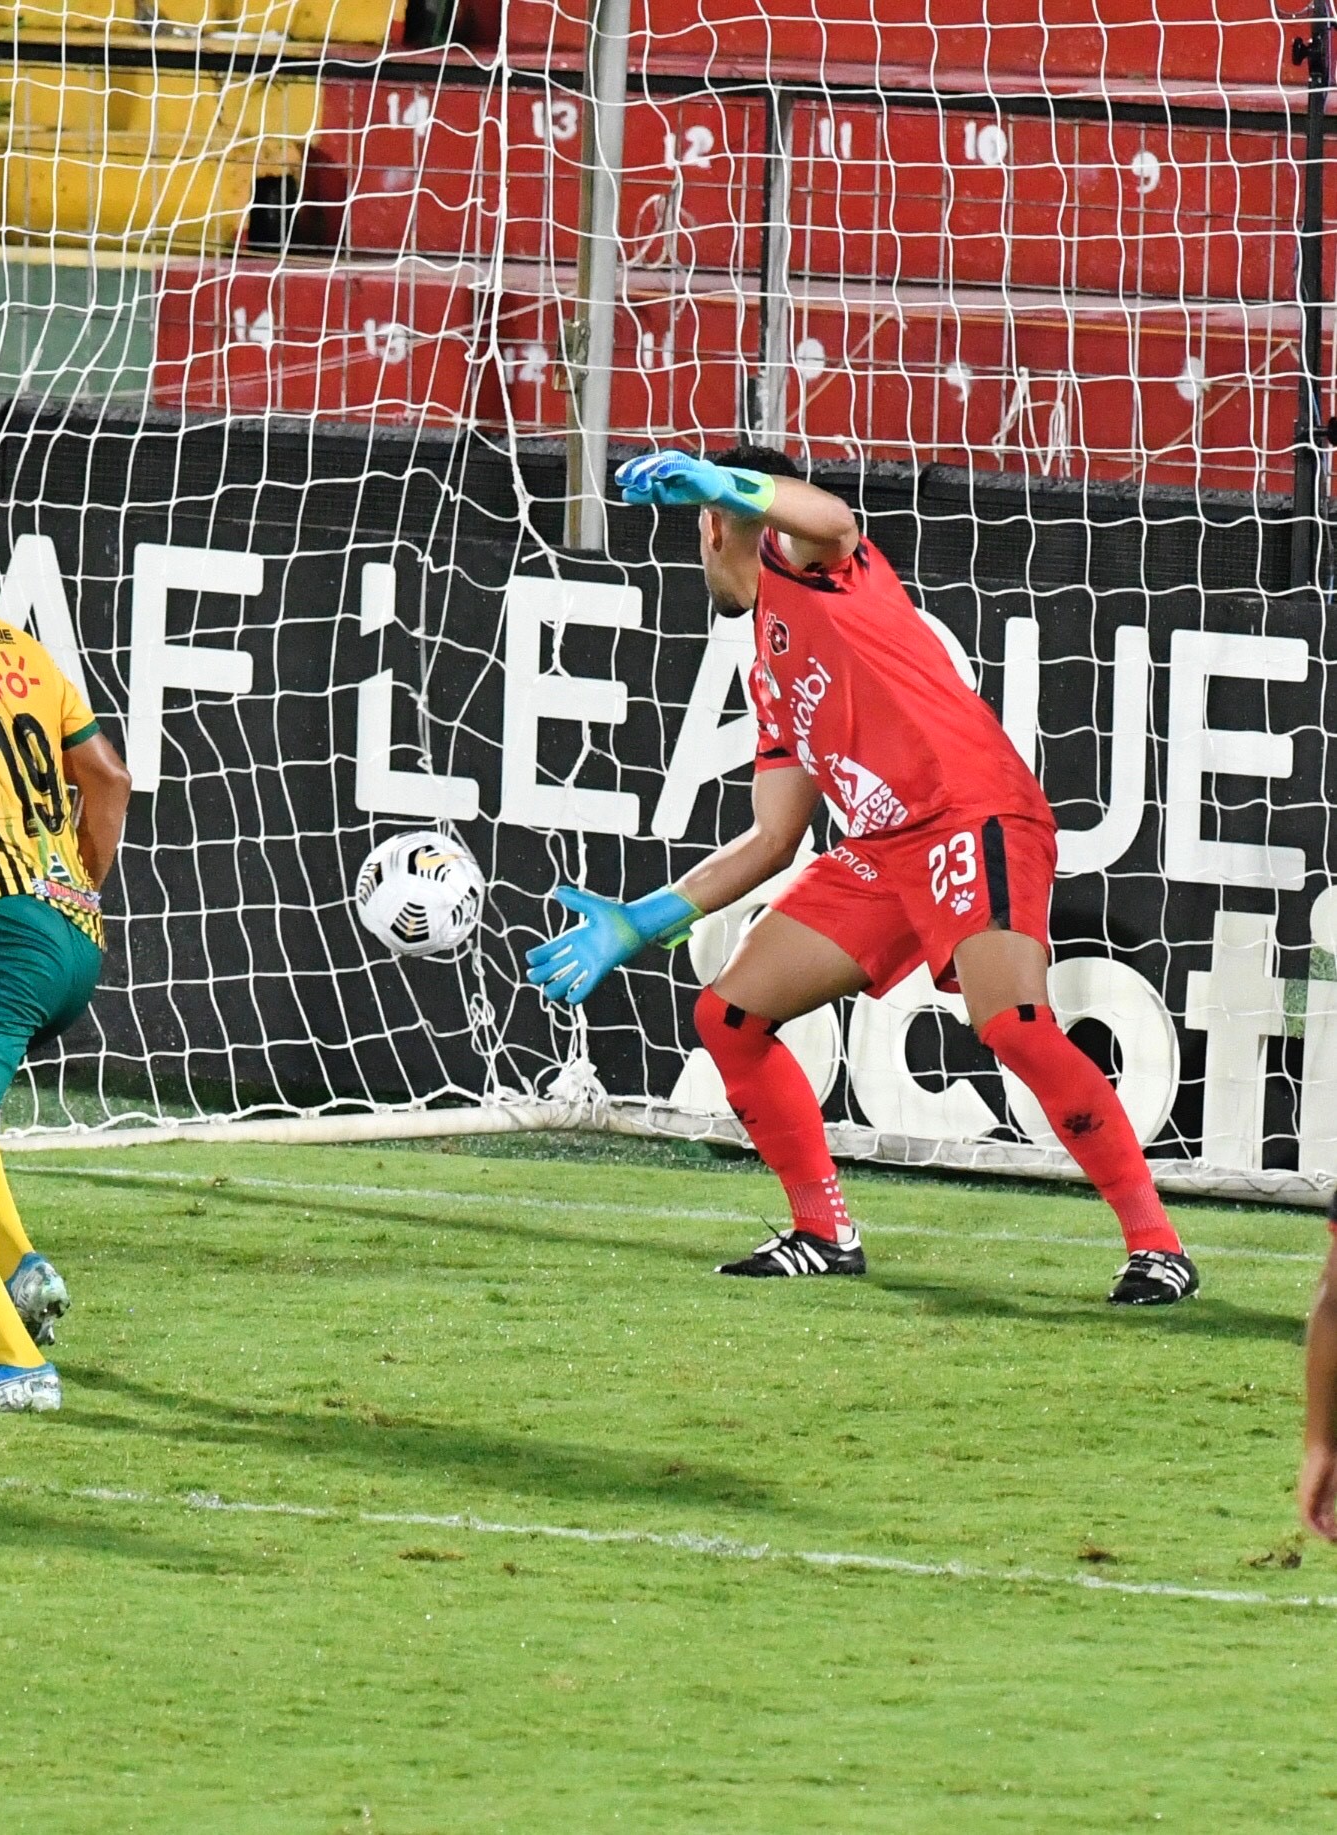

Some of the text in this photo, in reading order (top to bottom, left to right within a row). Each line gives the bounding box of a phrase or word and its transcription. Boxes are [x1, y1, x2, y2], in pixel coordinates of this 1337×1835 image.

[531, 100, 578, 141] 13
[818, 116, 853, 161] 11
[964, 119, 1008, 166] 10
[664, 124, 715, 170] 12
[1131, 150, 1160, 194] 9
[355, 561, 1309, 892] LEAUE
[928, 831, 977, 904] 23
